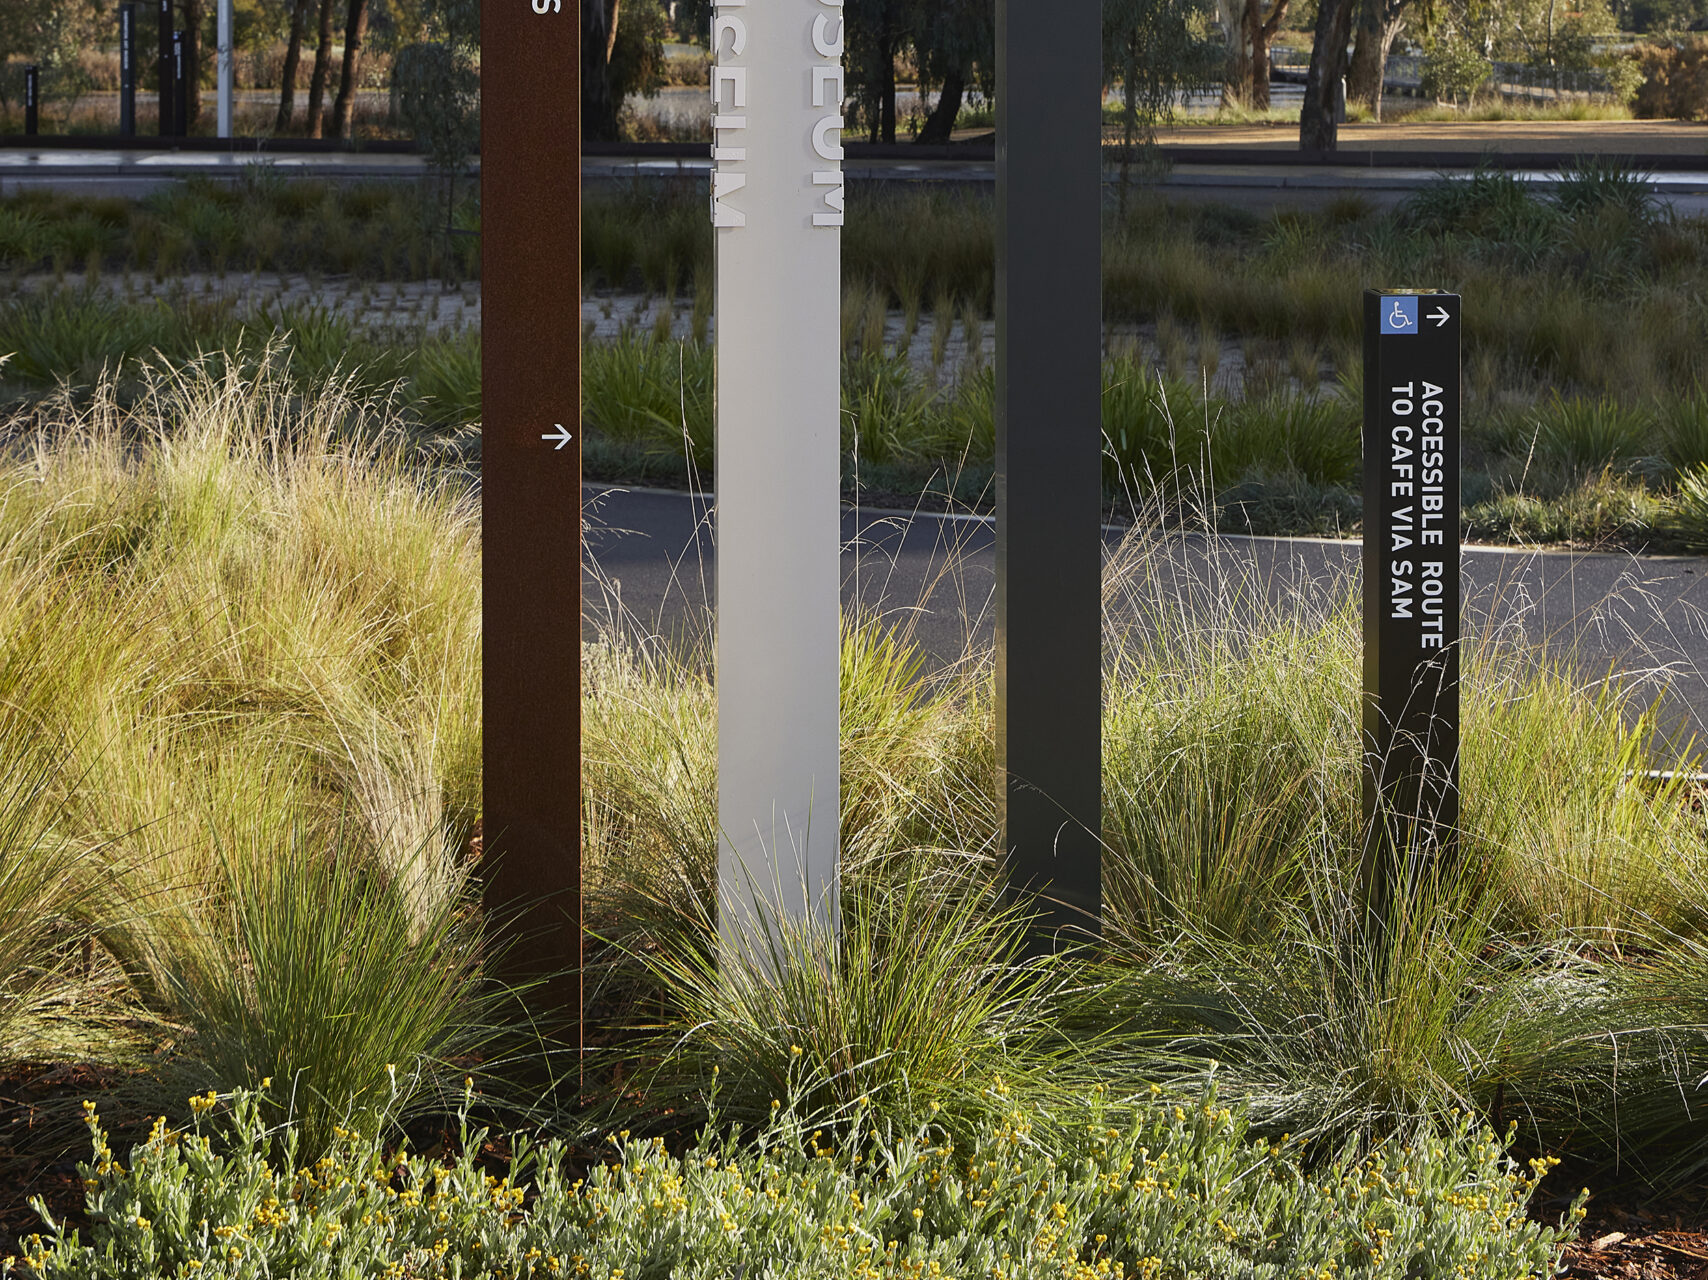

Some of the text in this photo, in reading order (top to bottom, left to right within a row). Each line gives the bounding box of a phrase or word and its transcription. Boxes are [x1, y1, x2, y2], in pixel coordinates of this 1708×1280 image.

[1391, 381, 1414, 618] TO CAFE VIA SAM
[1421, 380, 1444, 649] ACCESSIBLE ROUTE
